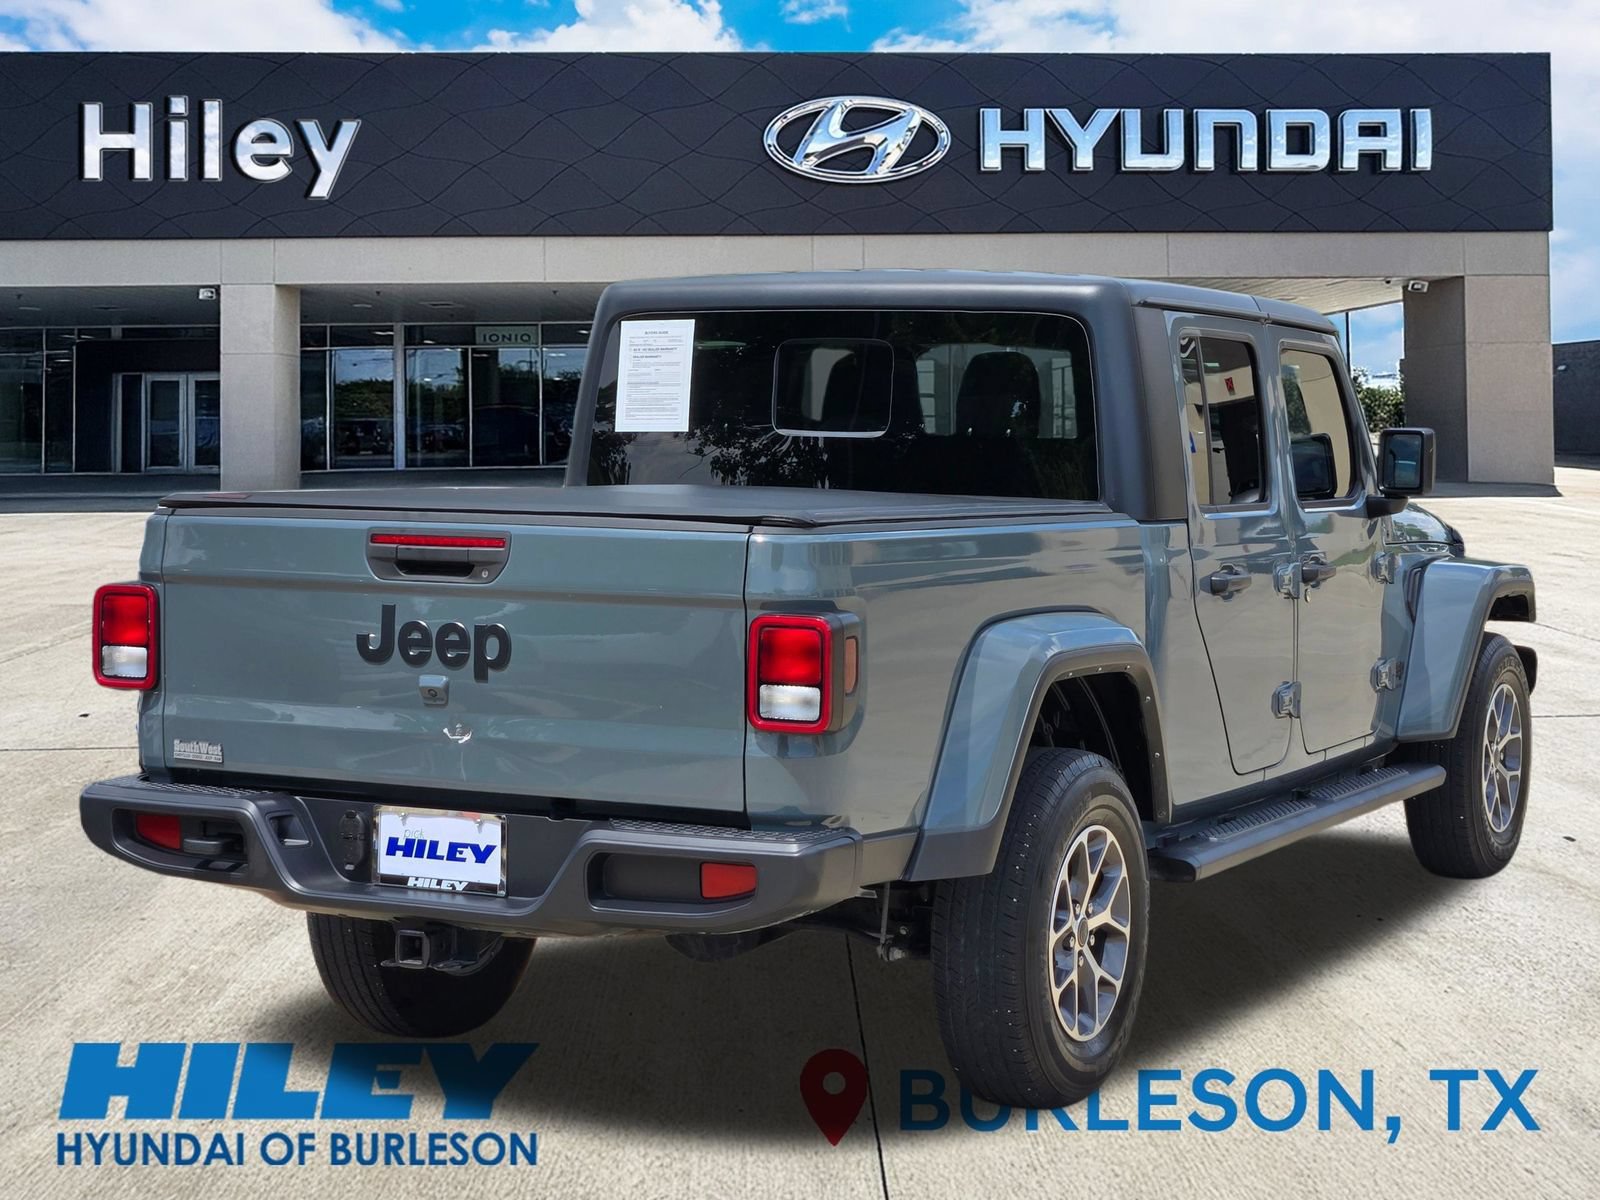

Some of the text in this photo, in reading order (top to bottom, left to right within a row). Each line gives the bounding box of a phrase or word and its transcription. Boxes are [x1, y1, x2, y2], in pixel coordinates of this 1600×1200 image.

[80, 95, 362, 200] Hiley
[979, 107, 1432, 173] HYUNDAI
[483, 332, 532, 343] IONIQ
[356, 604, 512, 682] Jeep
[385, 836, 498, 864] HILEY
[407, 876, 469, 891] HILEY
